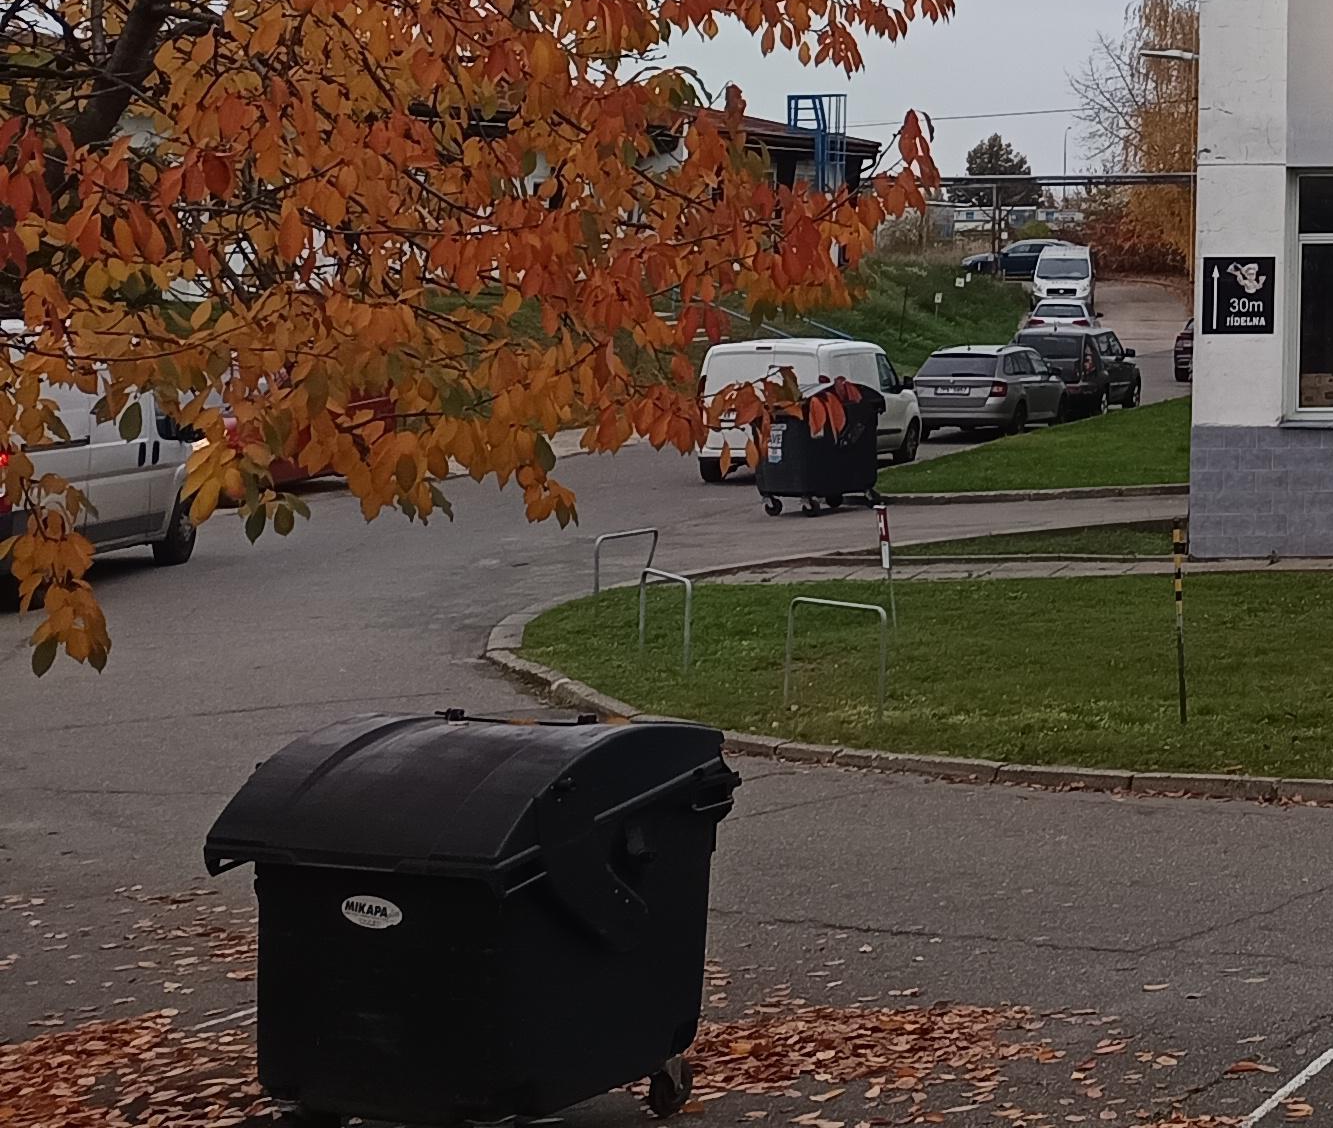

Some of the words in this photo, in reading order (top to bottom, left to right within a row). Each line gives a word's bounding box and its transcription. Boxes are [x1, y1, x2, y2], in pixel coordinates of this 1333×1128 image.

[1229, 297, 1263, 312] 30m
[1226, 314, 1266, 327] JÍDELNA
[345, 900, 388, 918] MIKAPA
